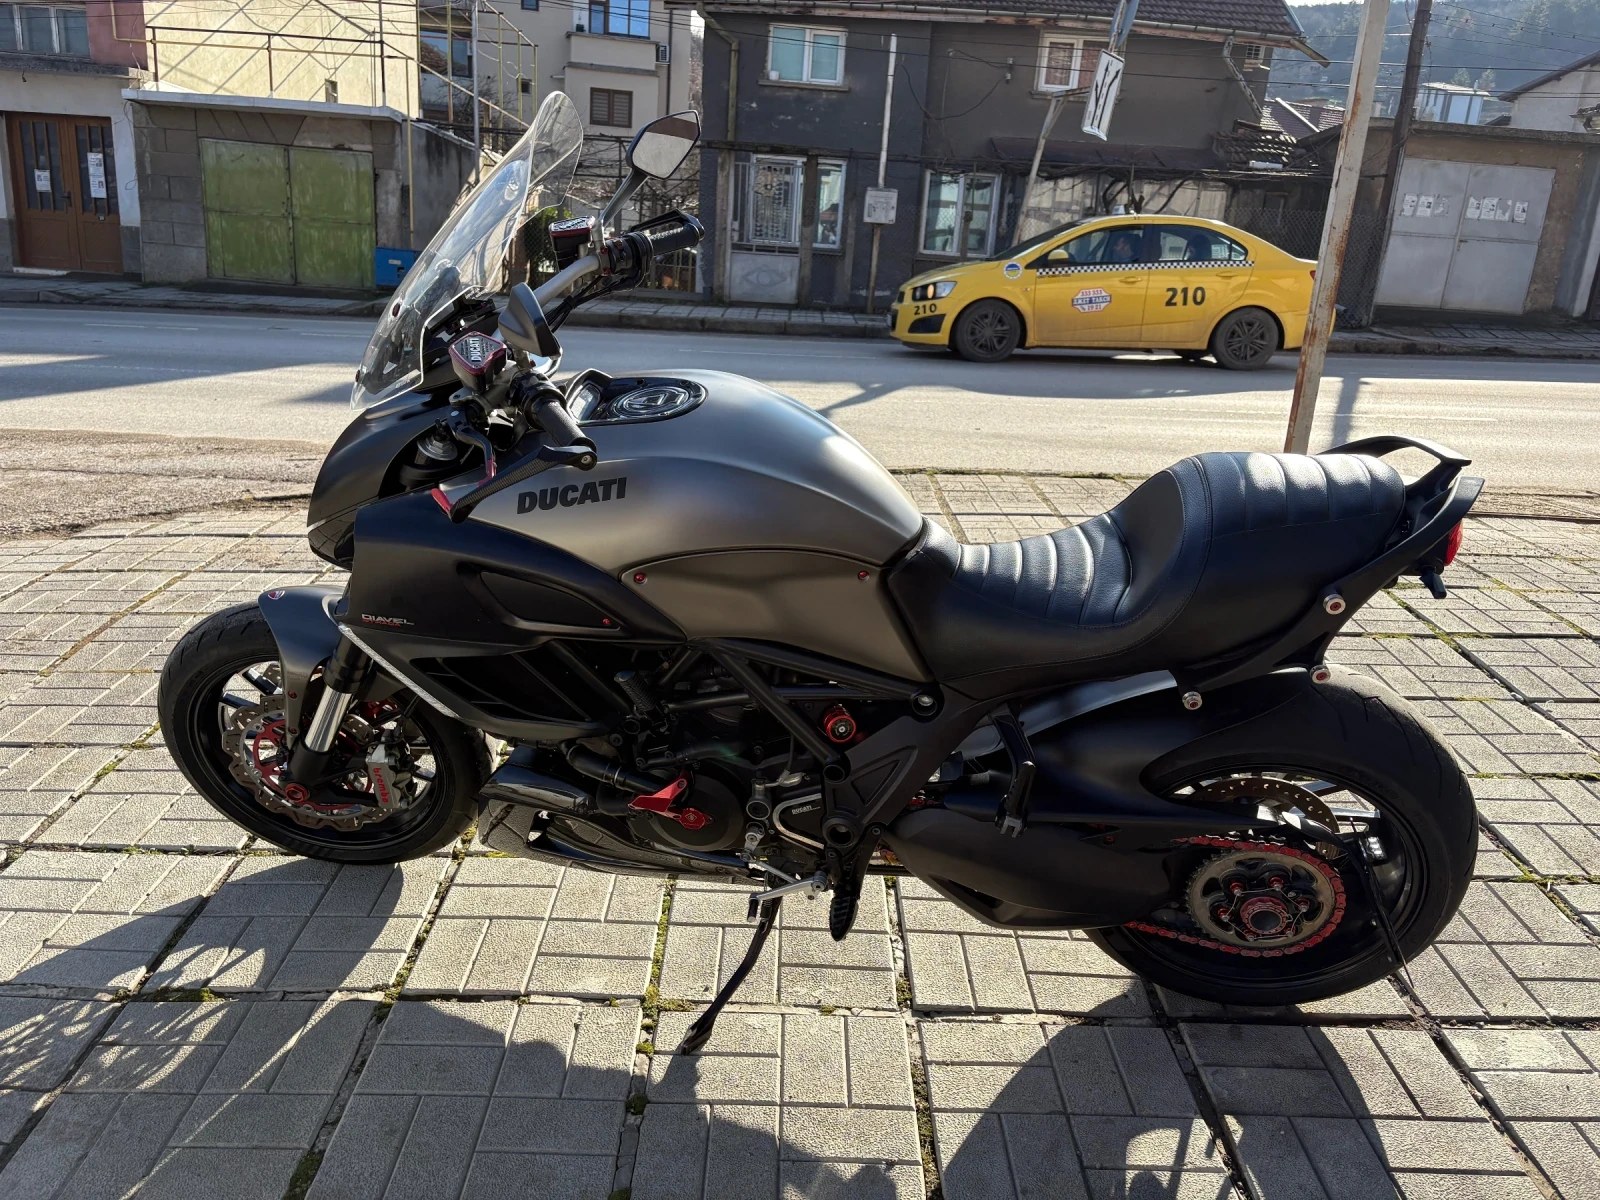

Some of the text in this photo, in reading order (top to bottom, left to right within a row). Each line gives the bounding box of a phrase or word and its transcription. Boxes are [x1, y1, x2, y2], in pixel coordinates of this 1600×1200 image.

[1165, 286, 1206, 307] 210
[914, 303, 937, 315] 210
[469, 338, 482, 361] DUCATI
[517, 477, 627, 514] DUCATI
[361, 613, 415, 625] DIAVEL
[373, 767, 390, 804] brembo
